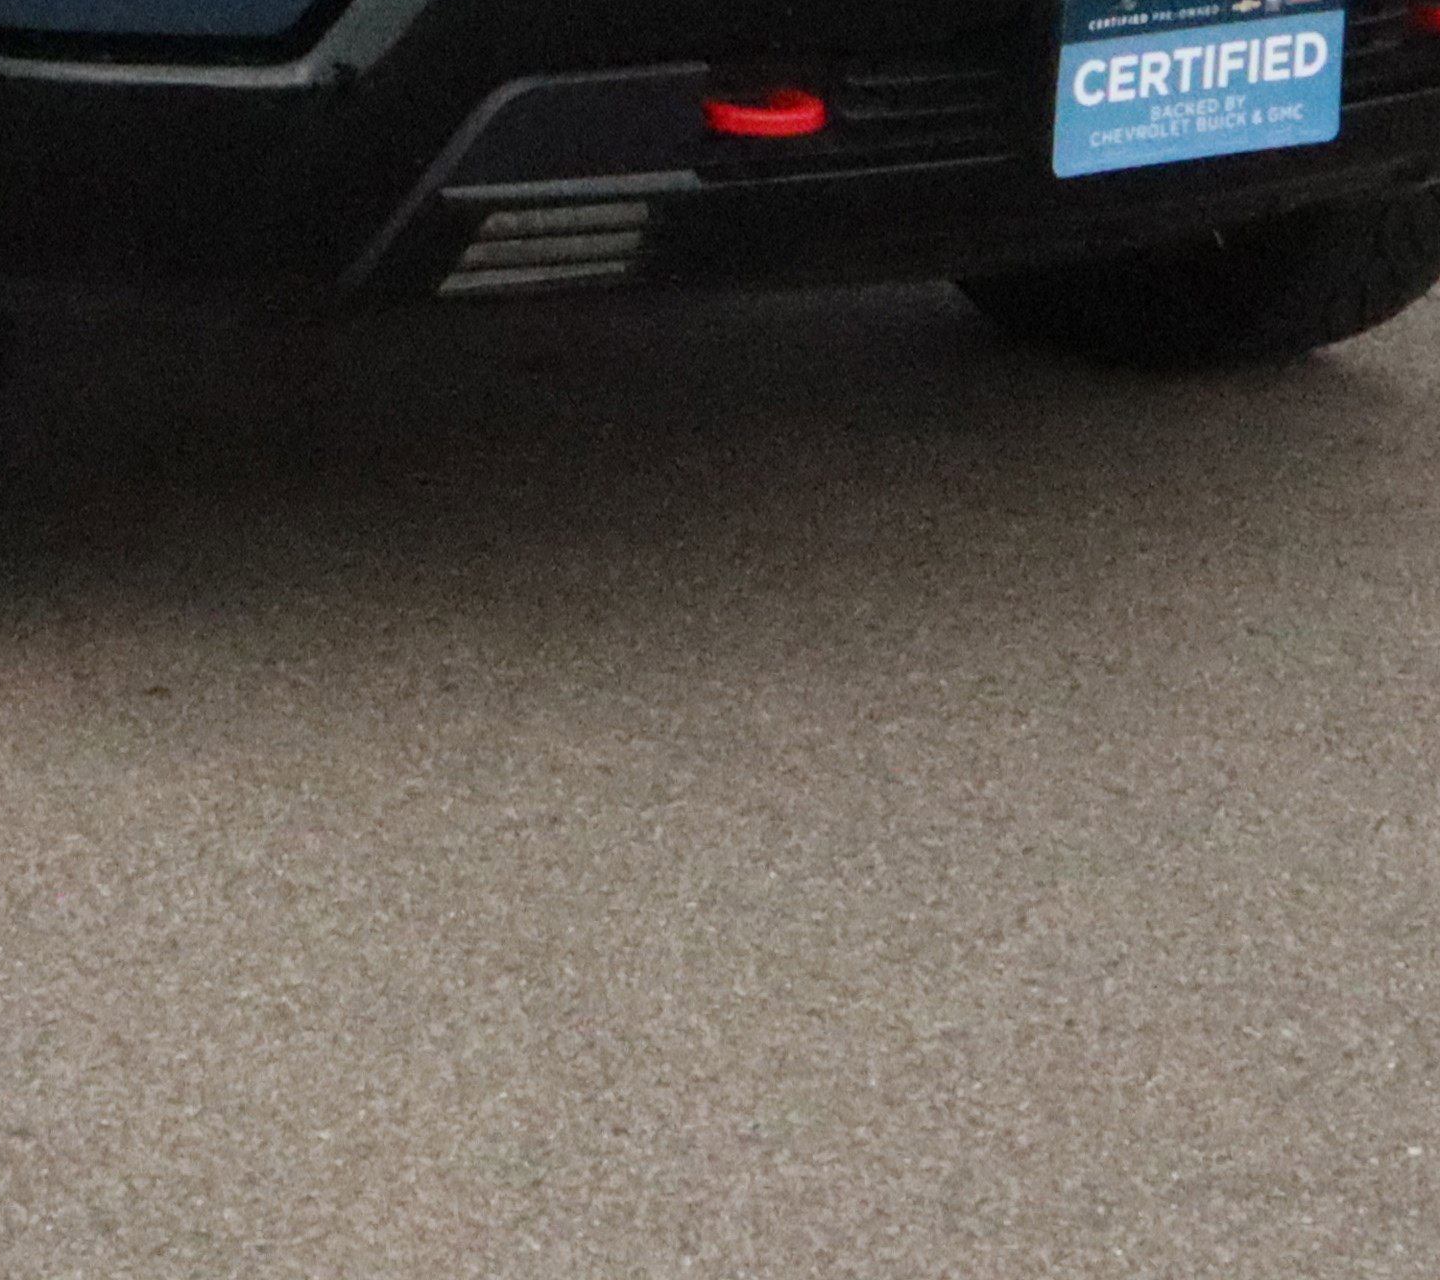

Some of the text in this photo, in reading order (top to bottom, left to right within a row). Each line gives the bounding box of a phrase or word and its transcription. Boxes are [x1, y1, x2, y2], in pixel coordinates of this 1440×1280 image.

[1073, 30, 1329, 108] CERTIFIED
[1088, 102, 1305, 148] CHEVROLET BUICK & GMC
[1149, 94, 1247, 123] BACKED BY
